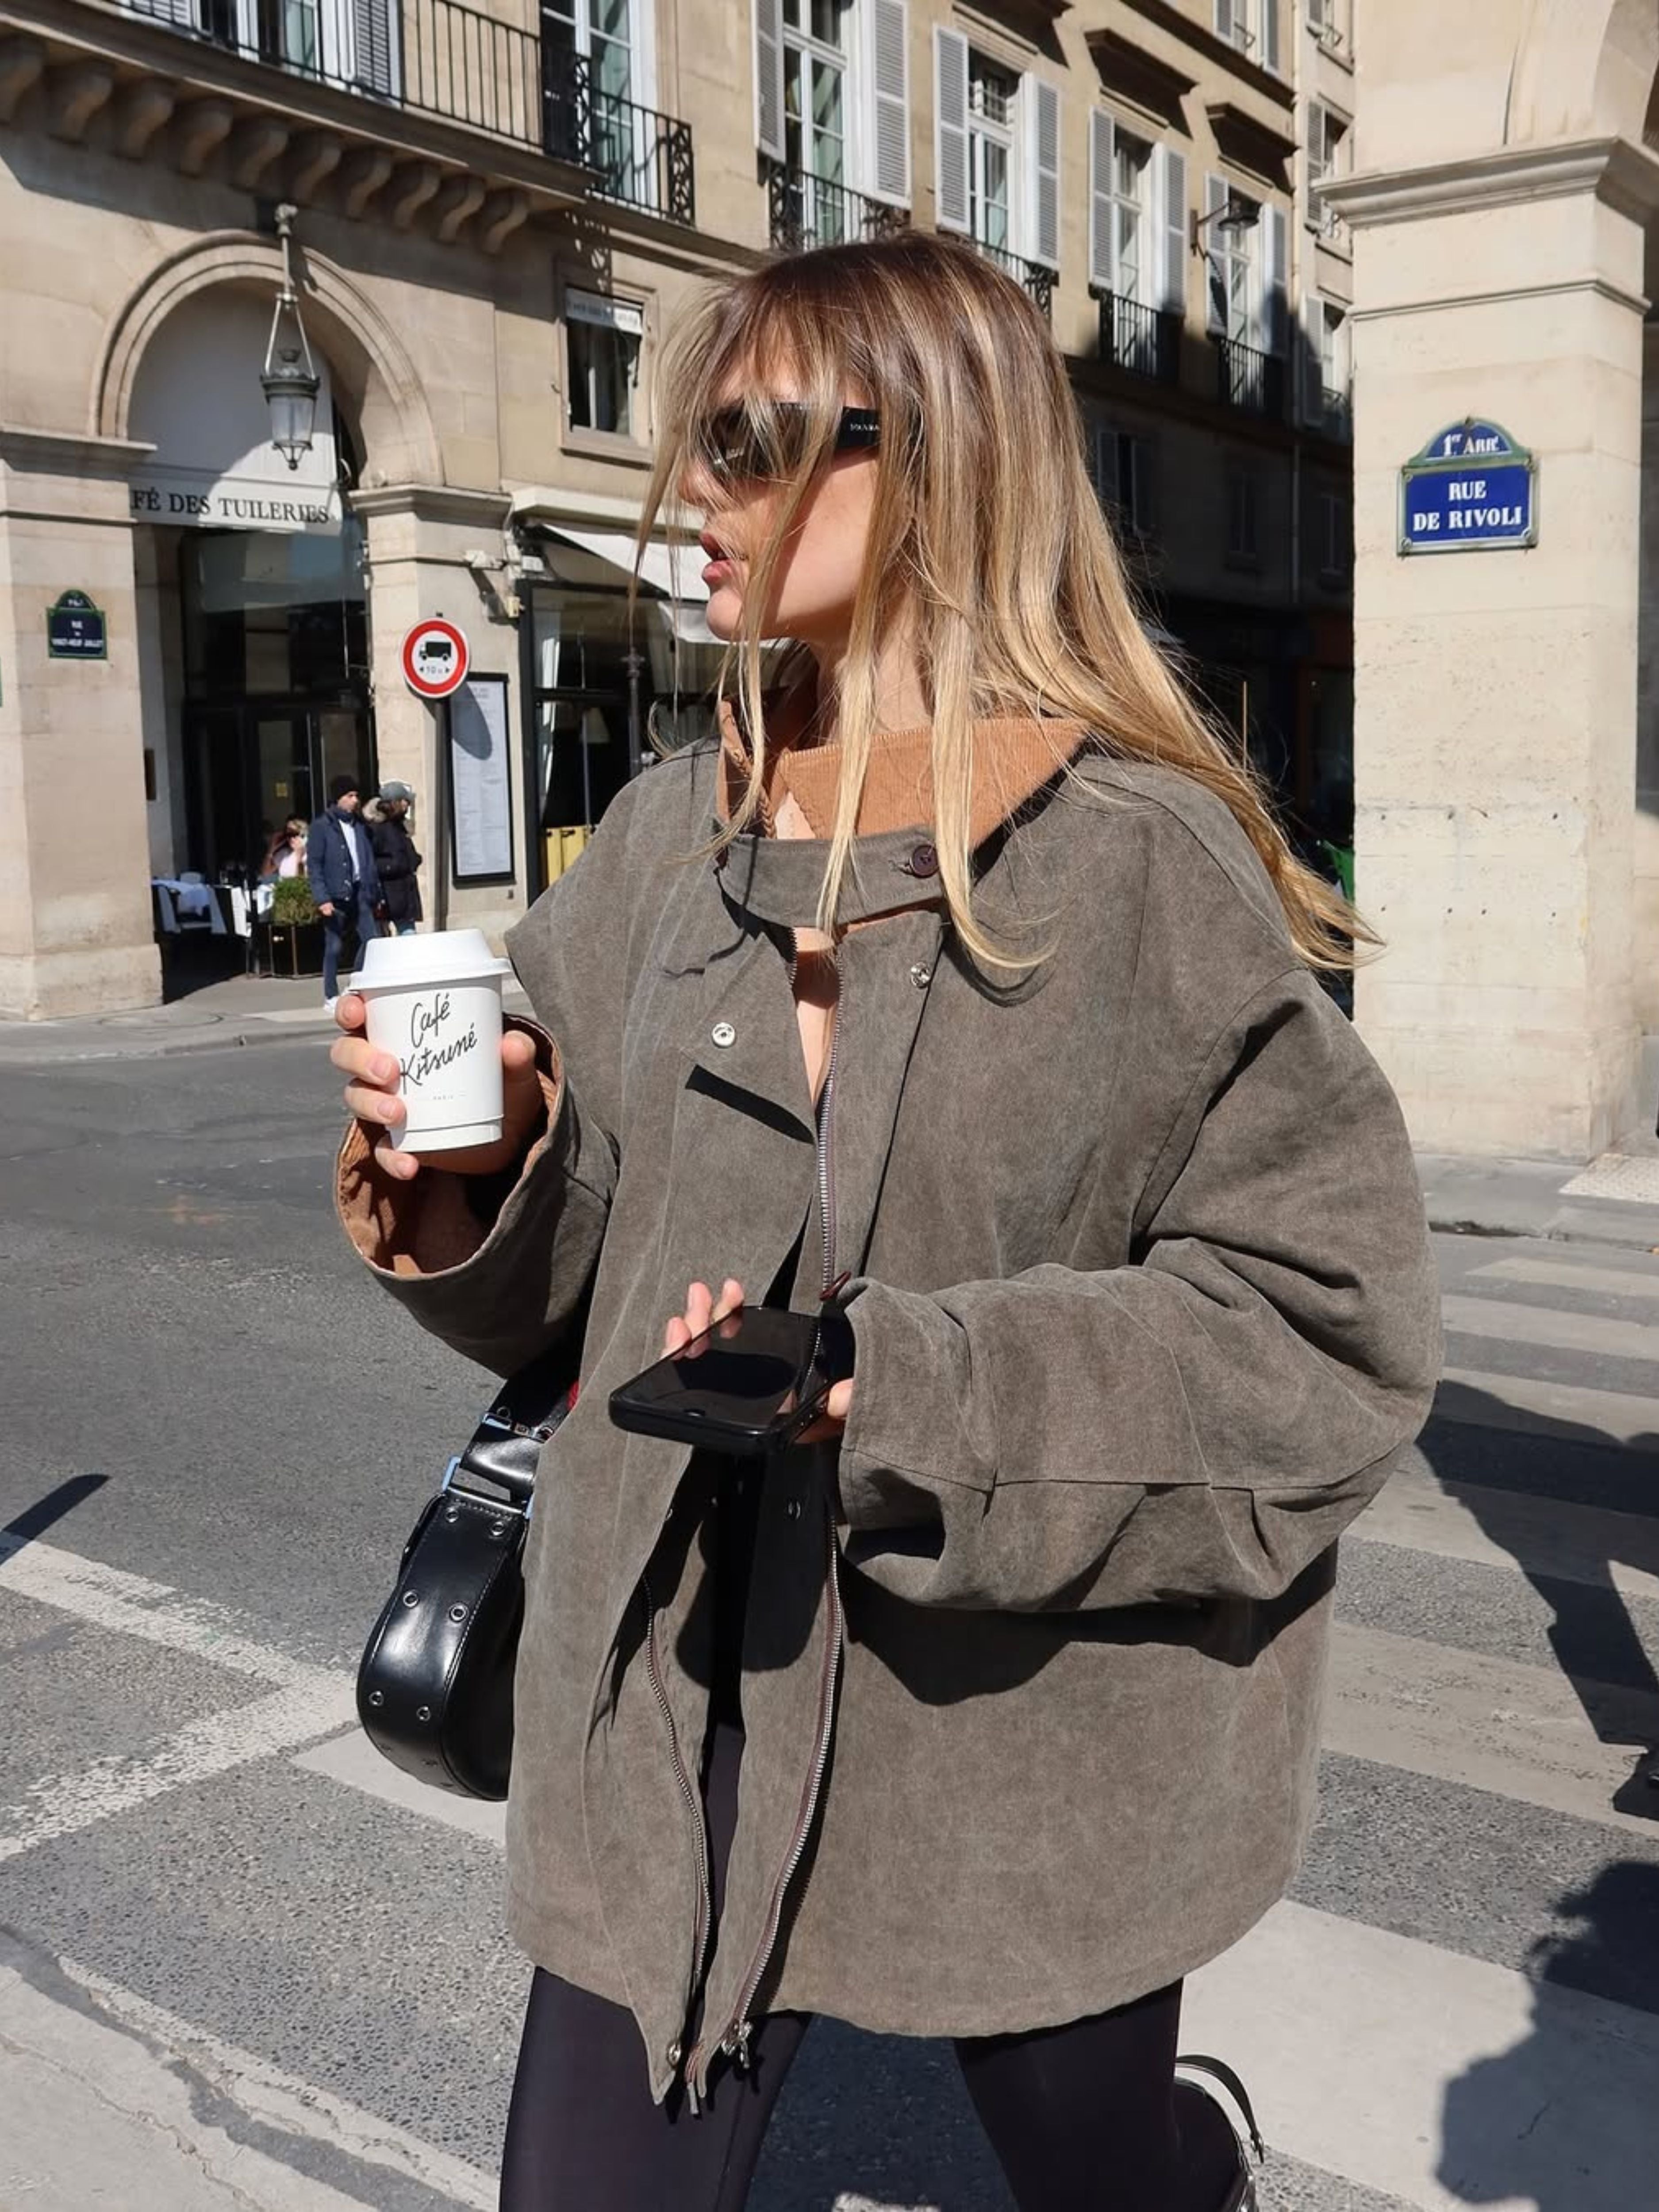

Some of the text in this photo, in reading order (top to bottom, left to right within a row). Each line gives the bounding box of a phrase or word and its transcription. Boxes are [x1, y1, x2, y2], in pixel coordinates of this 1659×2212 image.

[131, 487, 329, 524] FÉ DES TUILERIES
[1448, 480, 1487, 501] RUE
[1413, 506, 1522, 532] DE RIVOLI
[411, 993, 450, 1048] Café
[400, 1022, 478, 1095] Kitsuné
